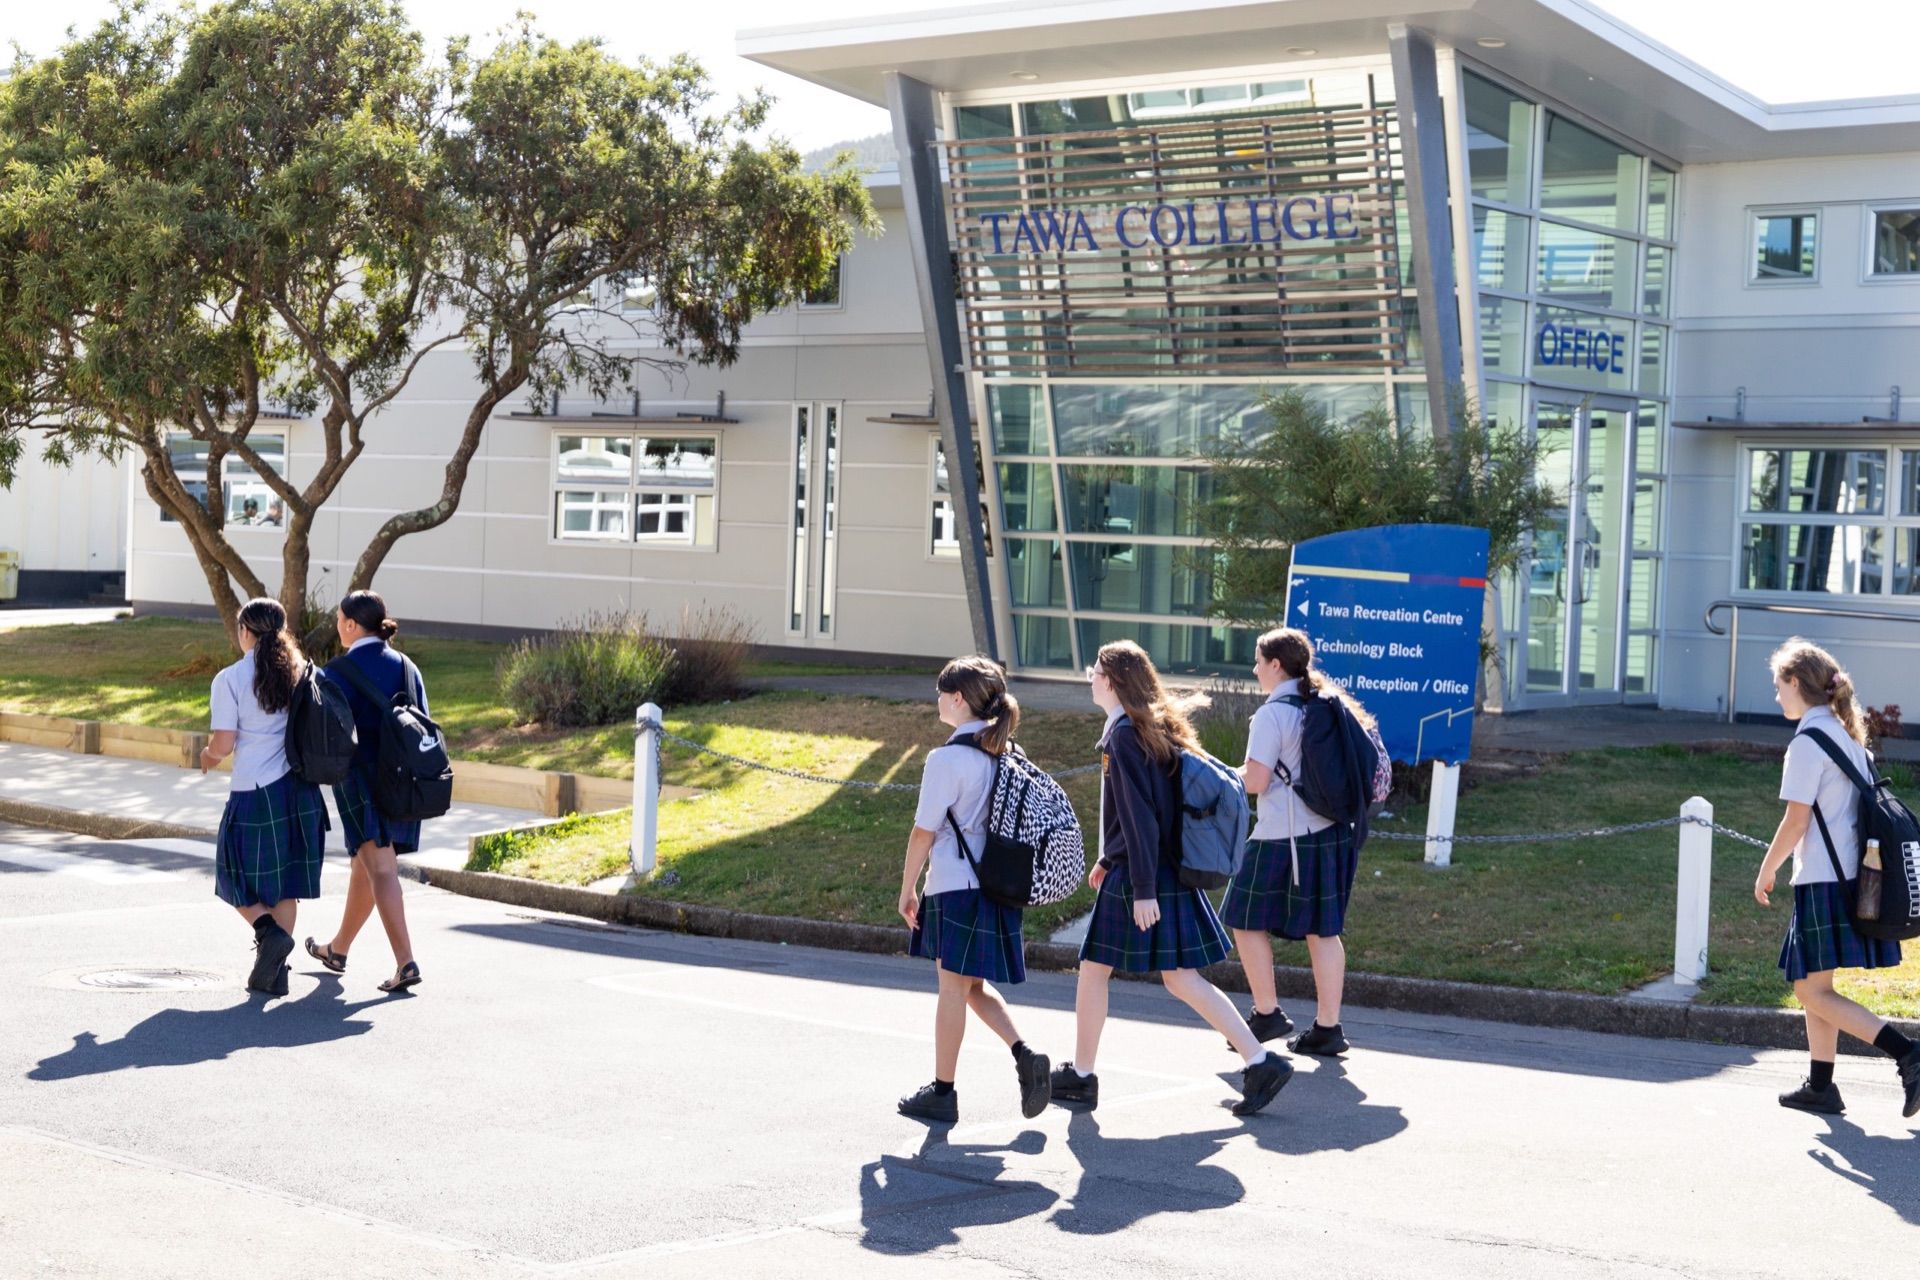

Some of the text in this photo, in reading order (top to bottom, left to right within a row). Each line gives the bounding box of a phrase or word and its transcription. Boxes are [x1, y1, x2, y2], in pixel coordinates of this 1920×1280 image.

[980, 194, 1358, 255] TAWA COLLEGE
[1540, 322, 1625, 374] OFFICE
[1318, 602, 1463, 625] Tawa Recreation Centre
[1314, 638, 1423, 658] Technology Block
[1325, 674, 1469, 694] hool Reception / Office
